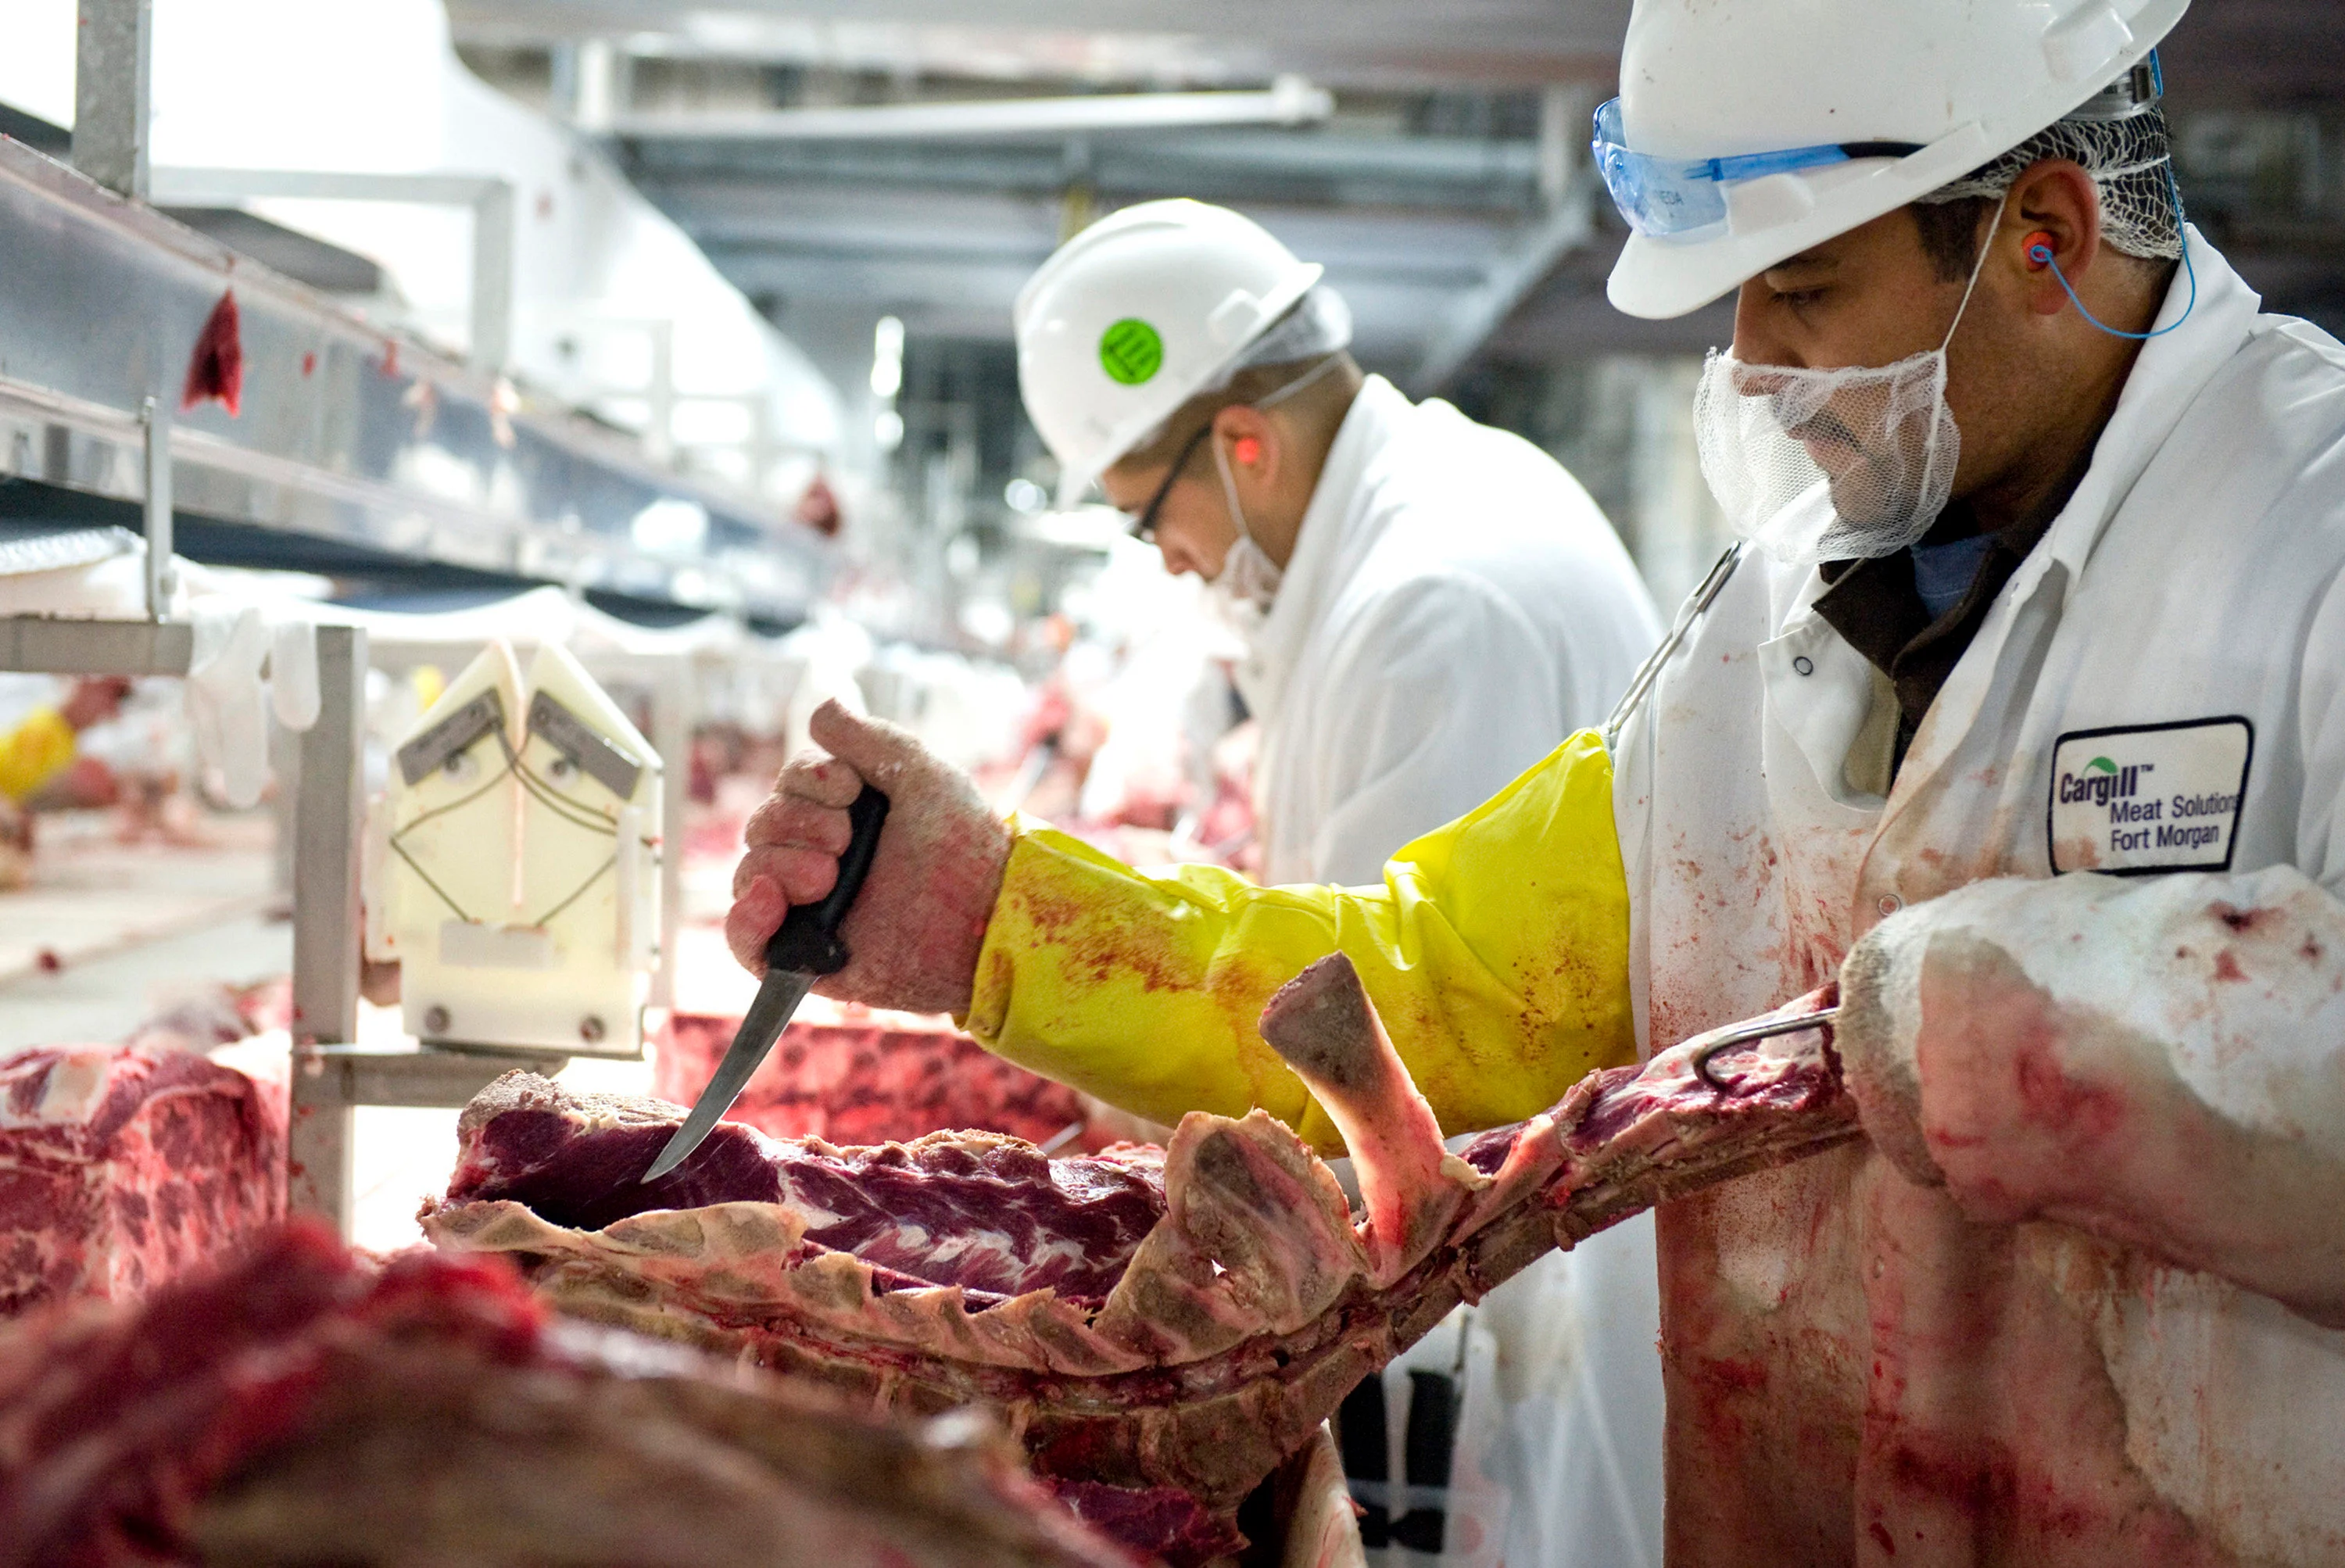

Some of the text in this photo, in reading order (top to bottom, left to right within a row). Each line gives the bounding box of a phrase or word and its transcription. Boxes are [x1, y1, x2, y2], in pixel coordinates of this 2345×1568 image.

[2110, 800, 2162, 823] Meat
[2110, 824, 2219, 852] Fort Morgan
